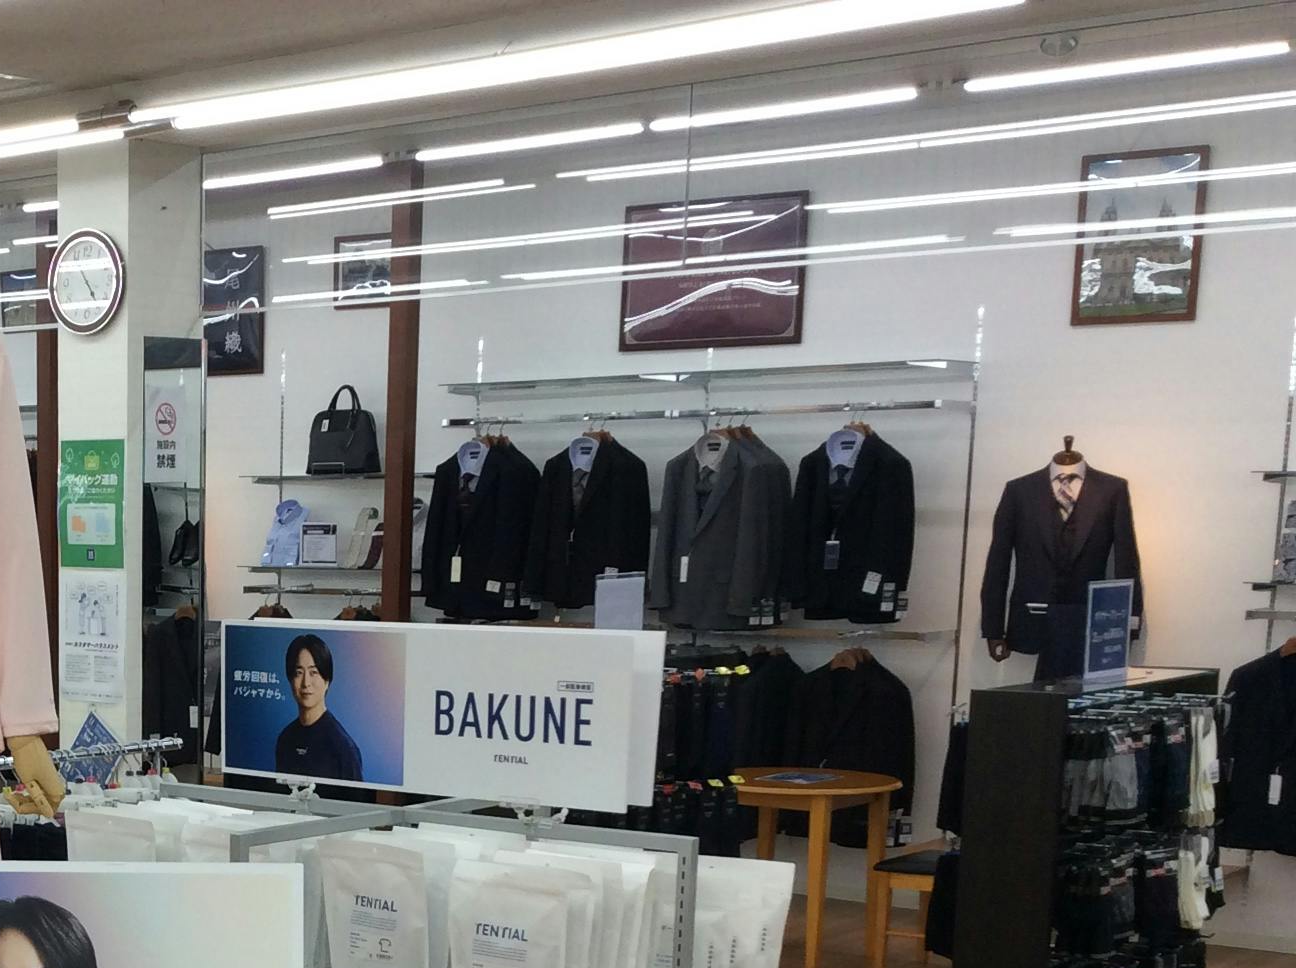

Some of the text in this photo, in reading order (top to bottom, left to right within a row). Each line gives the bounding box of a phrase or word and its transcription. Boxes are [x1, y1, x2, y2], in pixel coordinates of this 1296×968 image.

[156, 454, 176, 469] 禁煙
[233, 670, 280, 684] 疲労回復は、
[233, 686, 286, 700] パジャマから。
[434, 690, 593, 747] BAKUNE
[493, 754, 529, 765] TENTIAL
[353, 894, 398, 913] TENTIAL
[474, 922, 529, 942] TENTIAL
